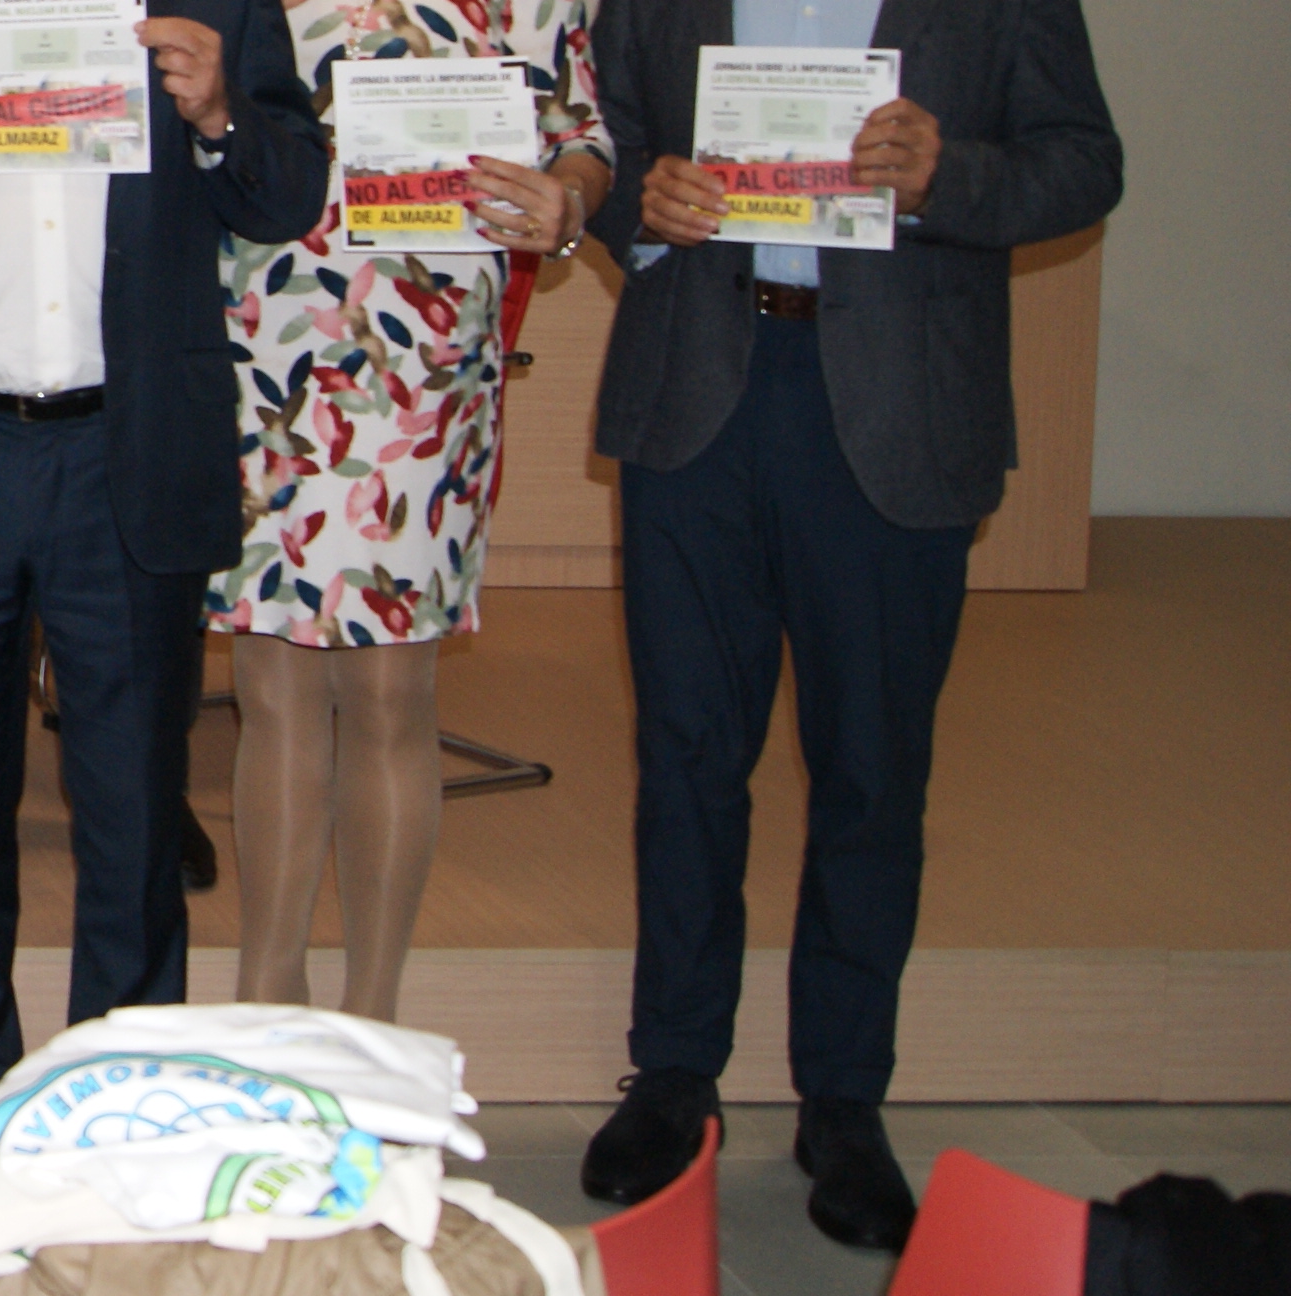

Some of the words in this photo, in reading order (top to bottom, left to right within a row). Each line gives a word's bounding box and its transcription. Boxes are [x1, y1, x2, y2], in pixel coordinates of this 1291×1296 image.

[735, 170, 763, 191] AL
[347, 184, 379, 204] NO
[386, 181, 414, 201] AL
[352, 210, 371, 224] DE
[381, 210, 454, 225] ALMARAZ
